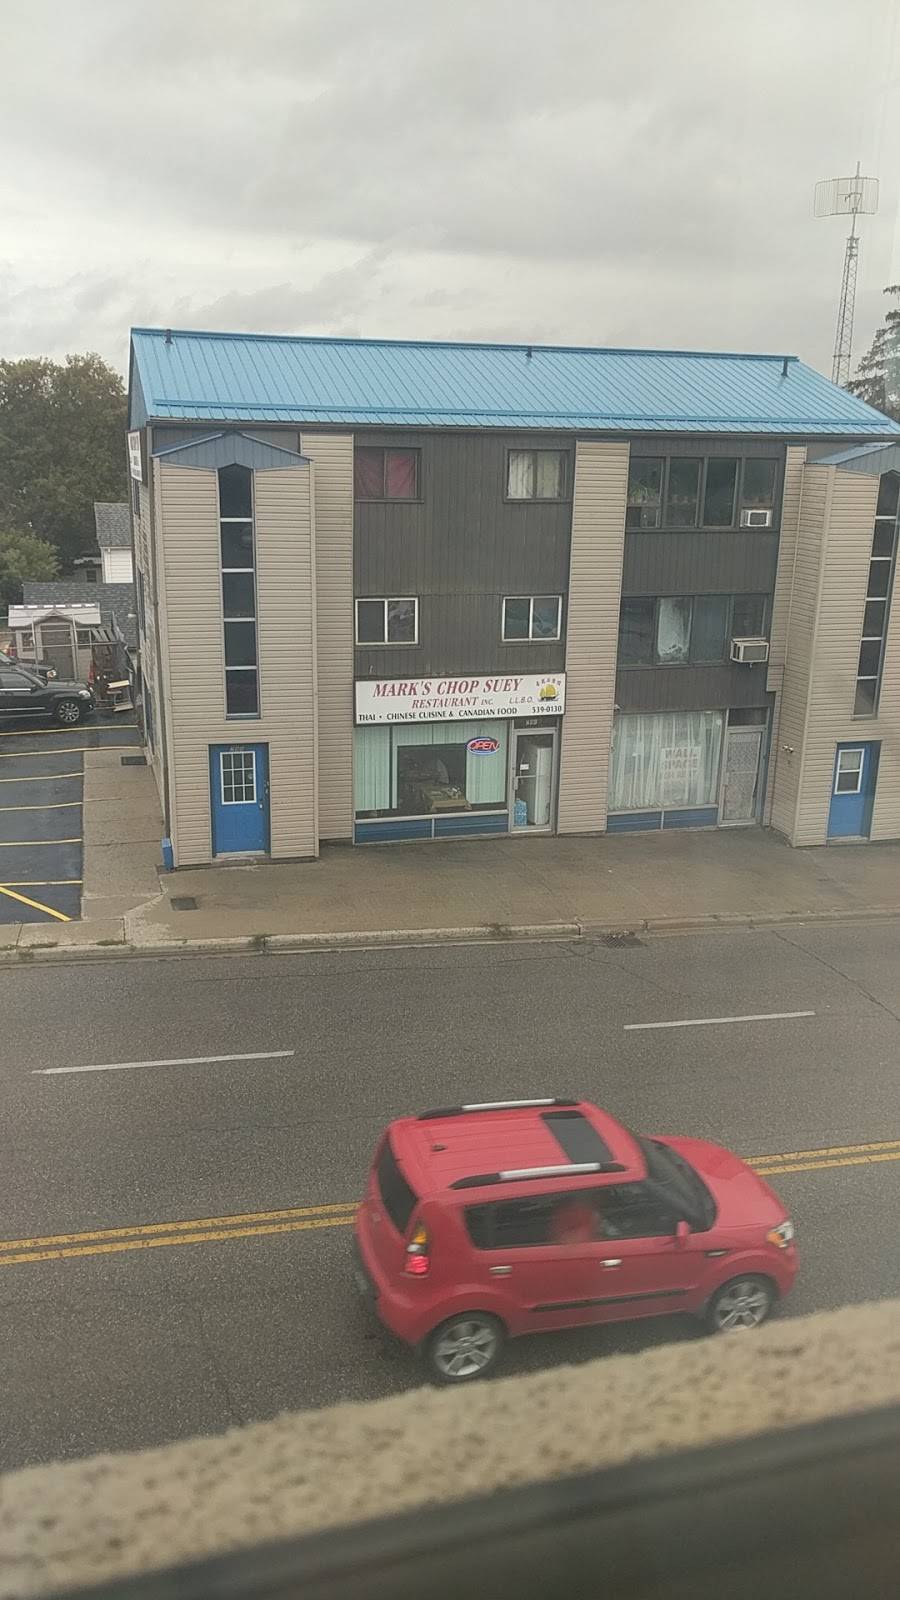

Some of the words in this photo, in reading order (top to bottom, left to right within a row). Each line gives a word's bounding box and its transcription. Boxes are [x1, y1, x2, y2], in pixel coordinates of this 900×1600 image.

[373, 681, 431, 697] MARK'S
[437, 680, 479, 695] CHOP
[483, 678, 522, 693] SUEY
[412, 697, 478, 709] RESTAURANT
[387, 712, 416, 720] CHINESE
[498, 707, 517, 715] FOOD
[470, 740, 499, 750] OPEN
